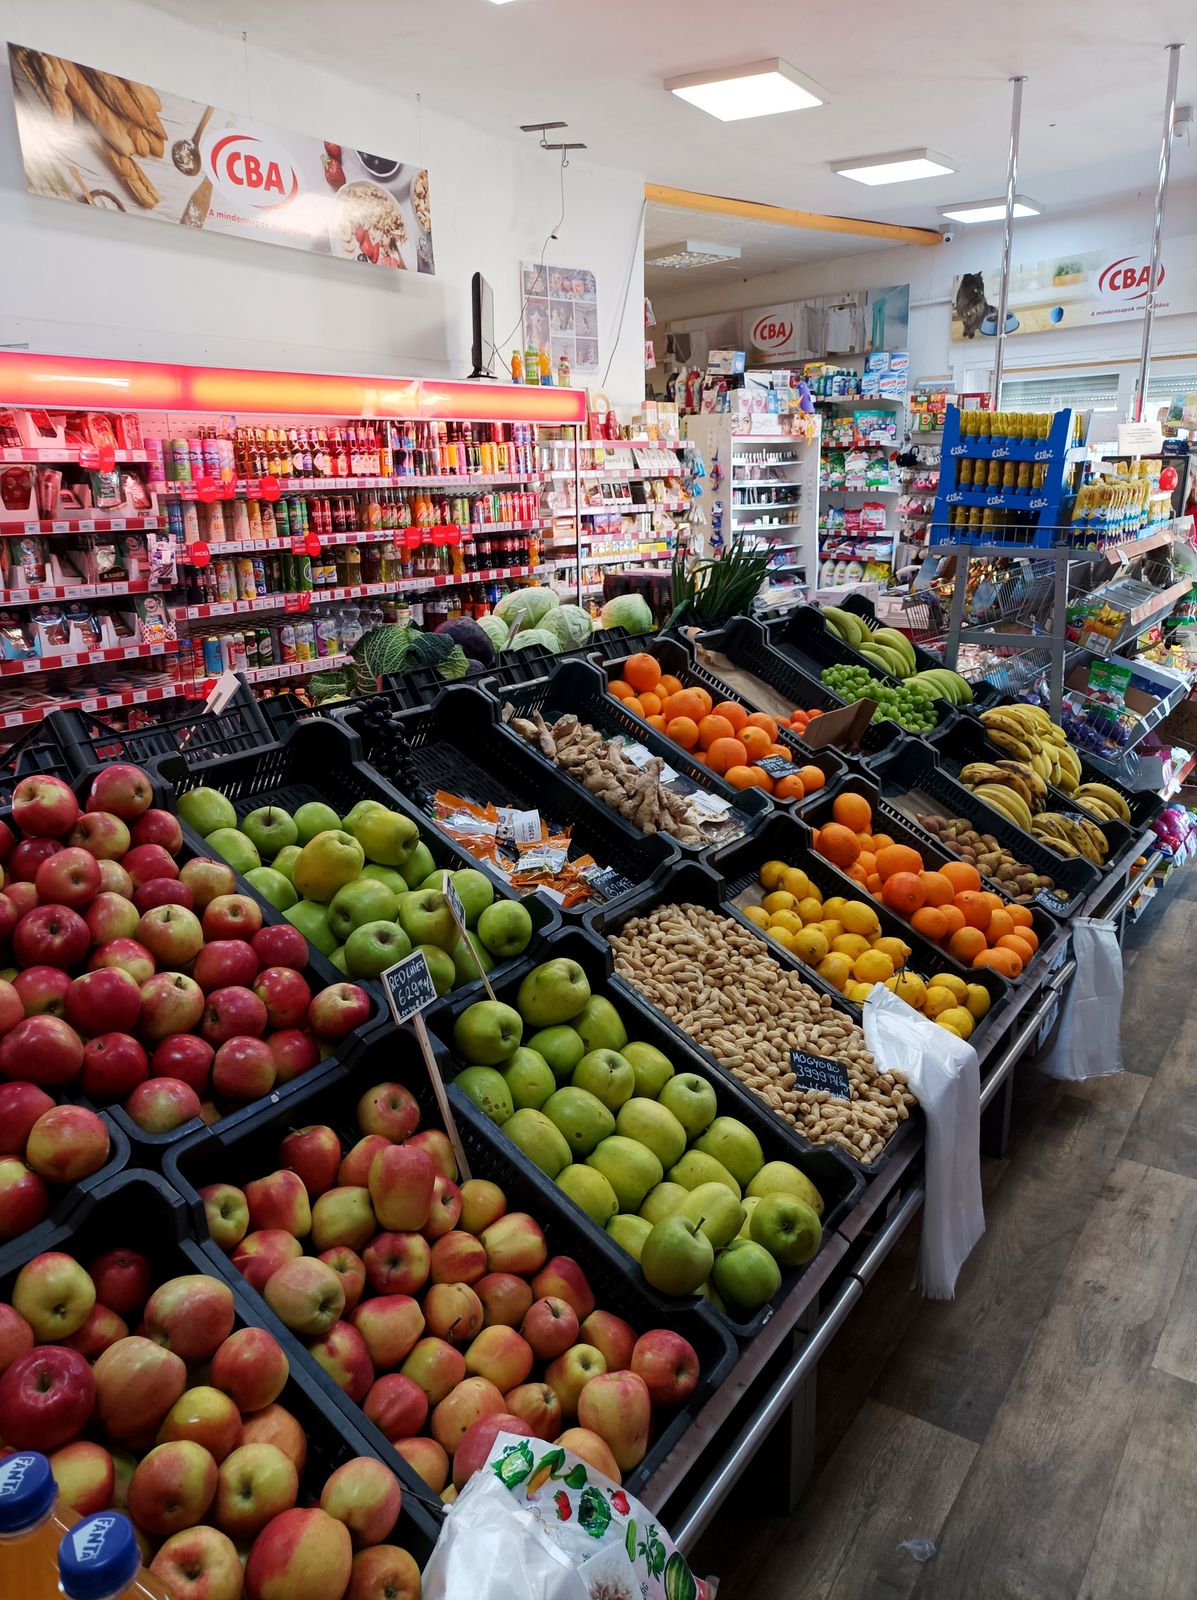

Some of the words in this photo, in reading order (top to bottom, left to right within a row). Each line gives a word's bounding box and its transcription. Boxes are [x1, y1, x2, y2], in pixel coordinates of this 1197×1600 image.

[226, 151, 286, 195] CBA
[1108, 265, 1152, 291] CBA
[760, 322, 787, 341] CBA
[950, 445, 968, 456] tibi
[991, 447, 1010, 458] tibi
[1034, 450, 1054, 461] tibi
[946, 492, 964, 503] tibi
[987, 495, 1006, 506] tibi
[1029, 498, 1049, 509] tibi
[398, 982, 420, 1006] 629
[0, 1456, 33, 1495] FANTA
[80, 1518, 112, 1560] FANTA
